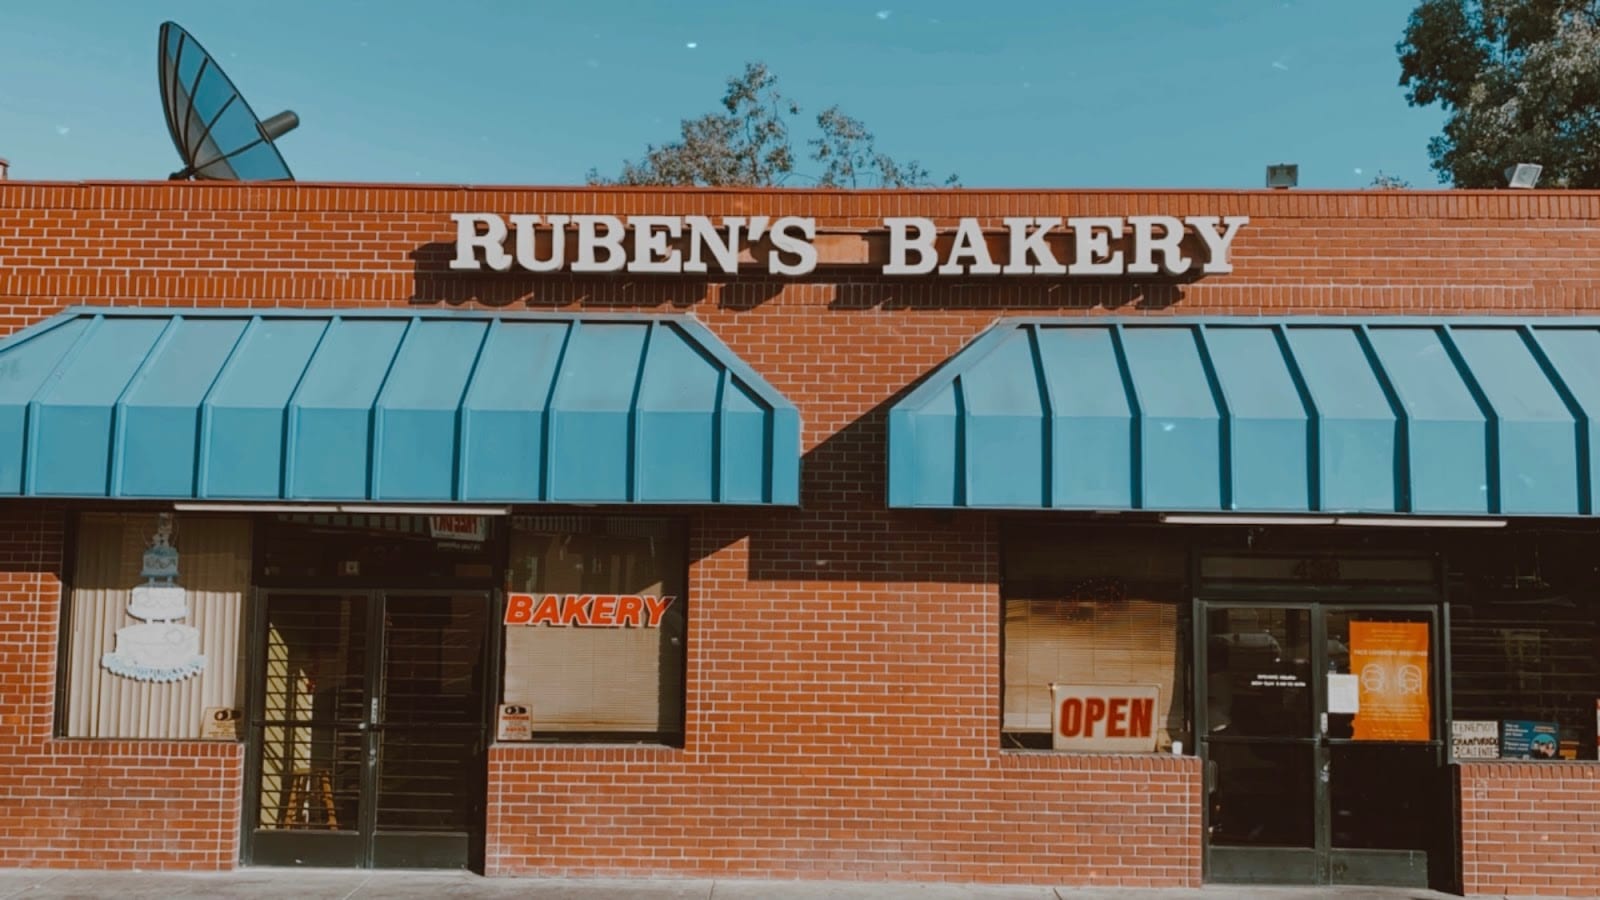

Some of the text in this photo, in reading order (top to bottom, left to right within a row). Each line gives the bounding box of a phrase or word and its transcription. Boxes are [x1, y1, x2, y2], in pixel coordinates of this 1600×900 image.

[449, 212, 1250, 276] RUBEN'S BAKERY
[504, 593, 677, 628] BAKERY
[1059, 697, 1155, 738] OPEN
